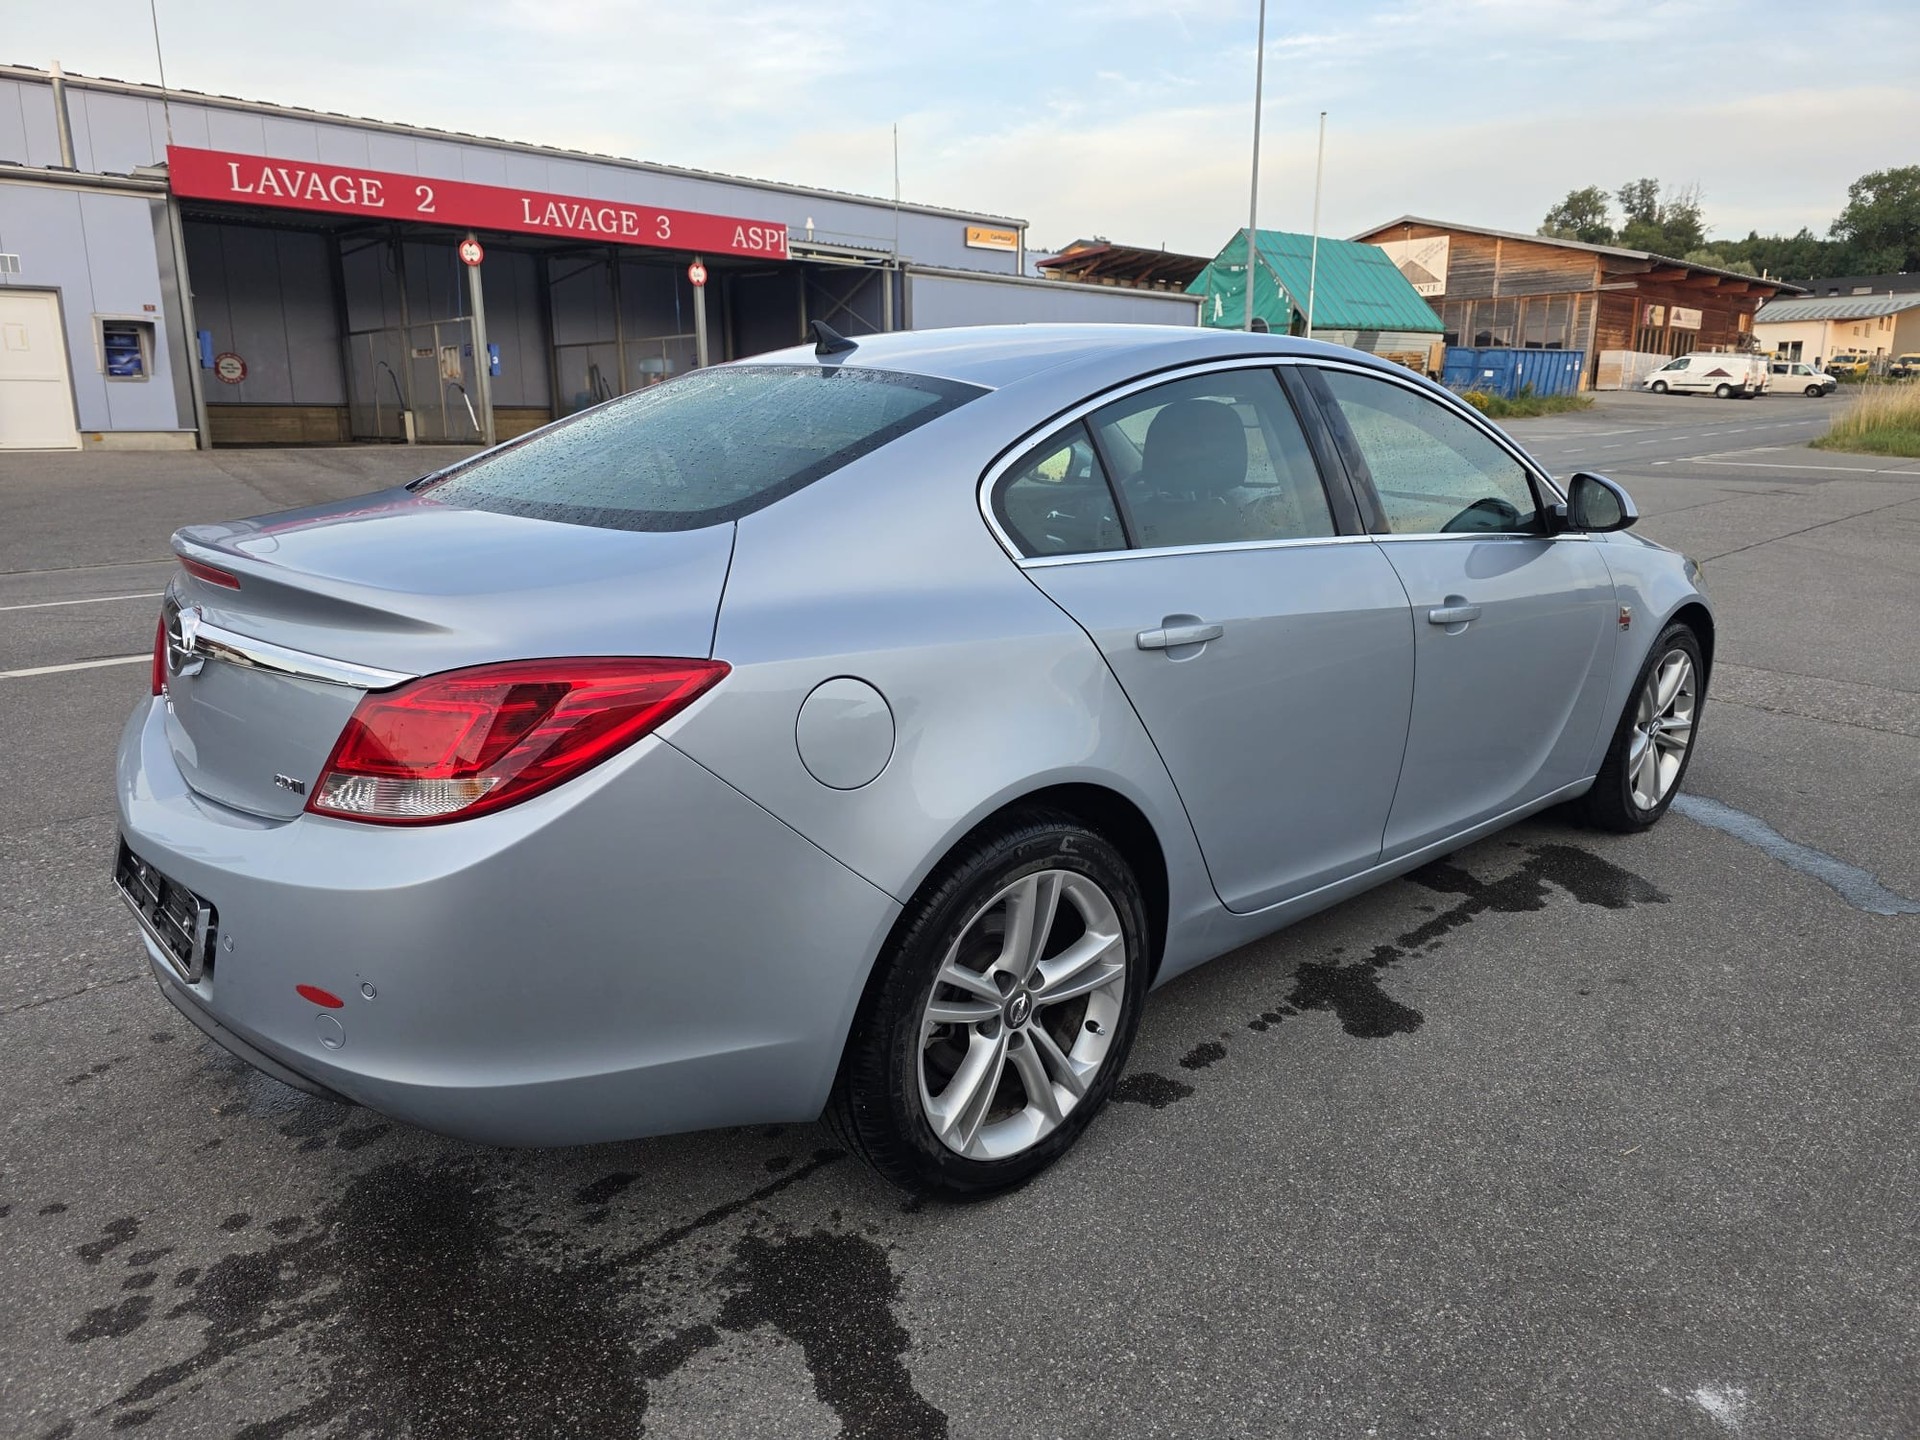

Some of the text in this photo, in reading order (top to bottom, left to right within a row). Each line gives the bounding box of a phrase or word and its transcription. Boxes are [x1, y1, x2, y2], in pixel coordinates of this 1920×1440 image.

[228, 162, 436, 214] LAVAGE 2
[521, 198, 671, 240] LAVAGE 3
